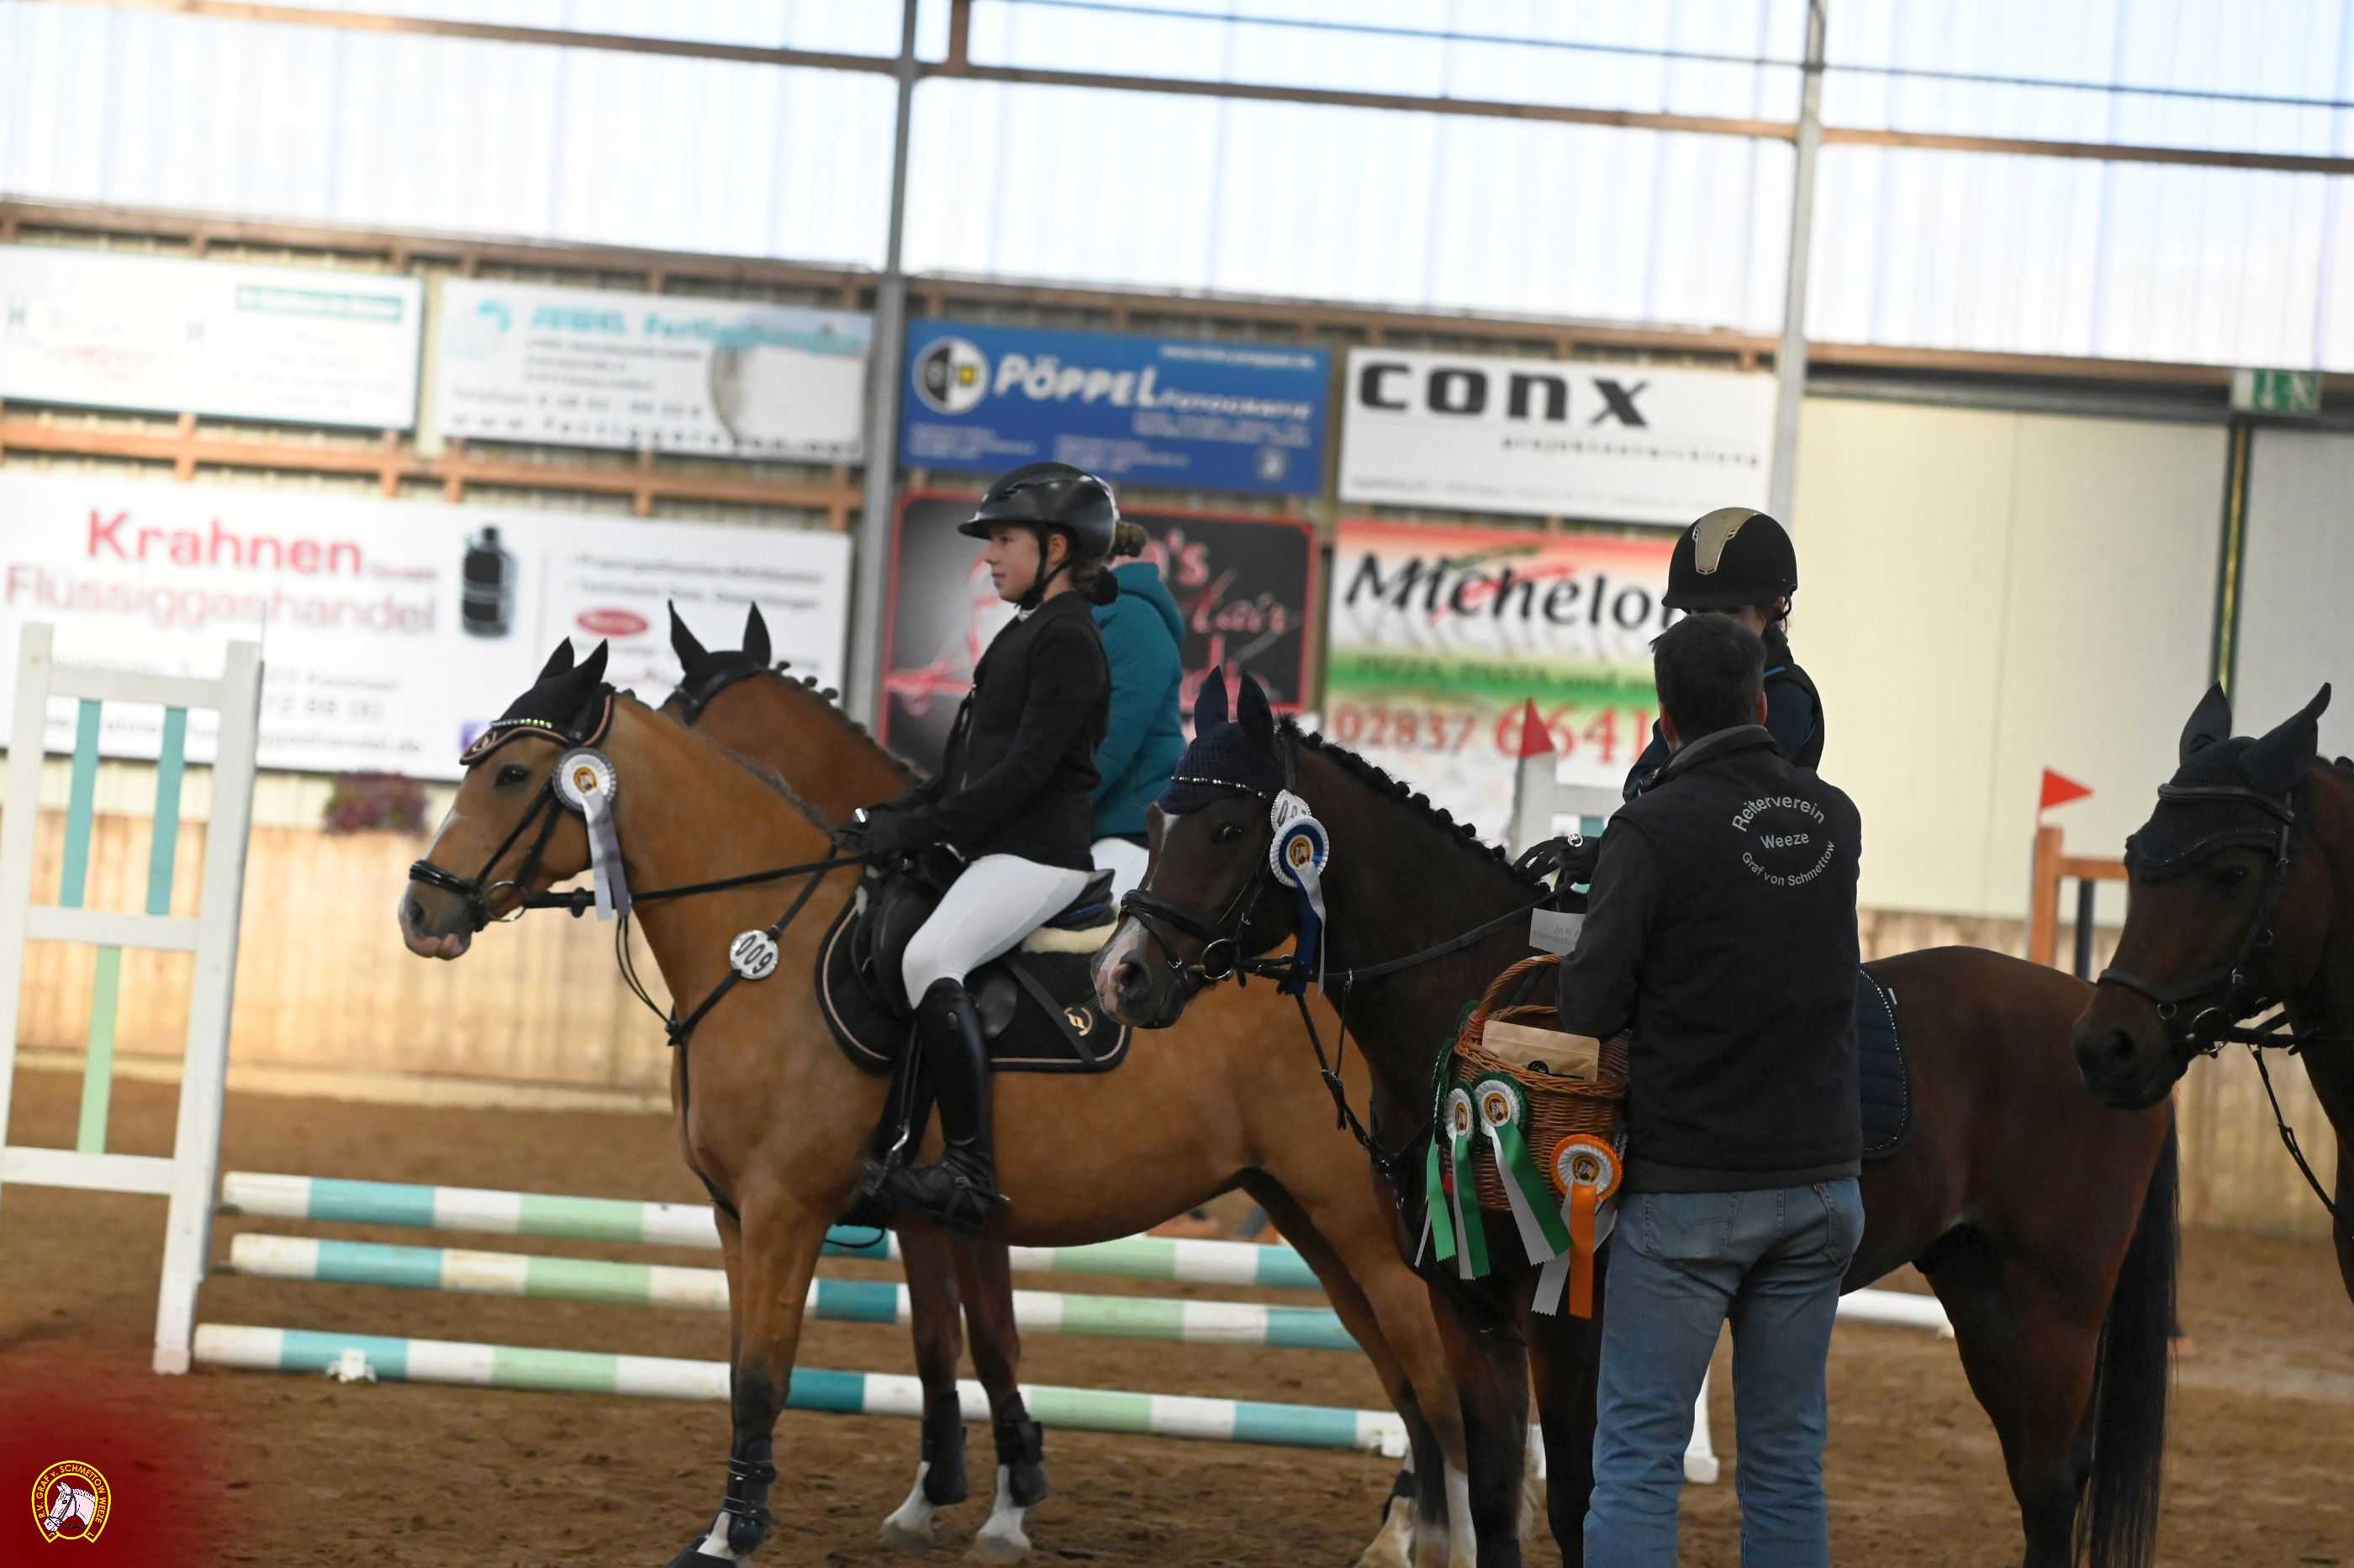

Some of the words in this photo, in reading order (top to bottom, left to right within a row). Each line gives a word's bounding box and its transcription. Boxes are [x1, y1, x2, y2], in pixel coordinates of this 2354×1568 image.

[1358, 362, 1649, 428] conx
[87, 508, 363, 576] Krahnen
[1333, 701, 1476, 753] 02837
[1731, 796, 1825, 832] Reiterverein
[1760, 832, 1809, 849] Weeze
[1742, 852, 1765, 875] Graf
[1765, 872, 1785, 886] von
[1787, 841, 1835, 886] Schmettow
[735, 934, 773, 974] 009
